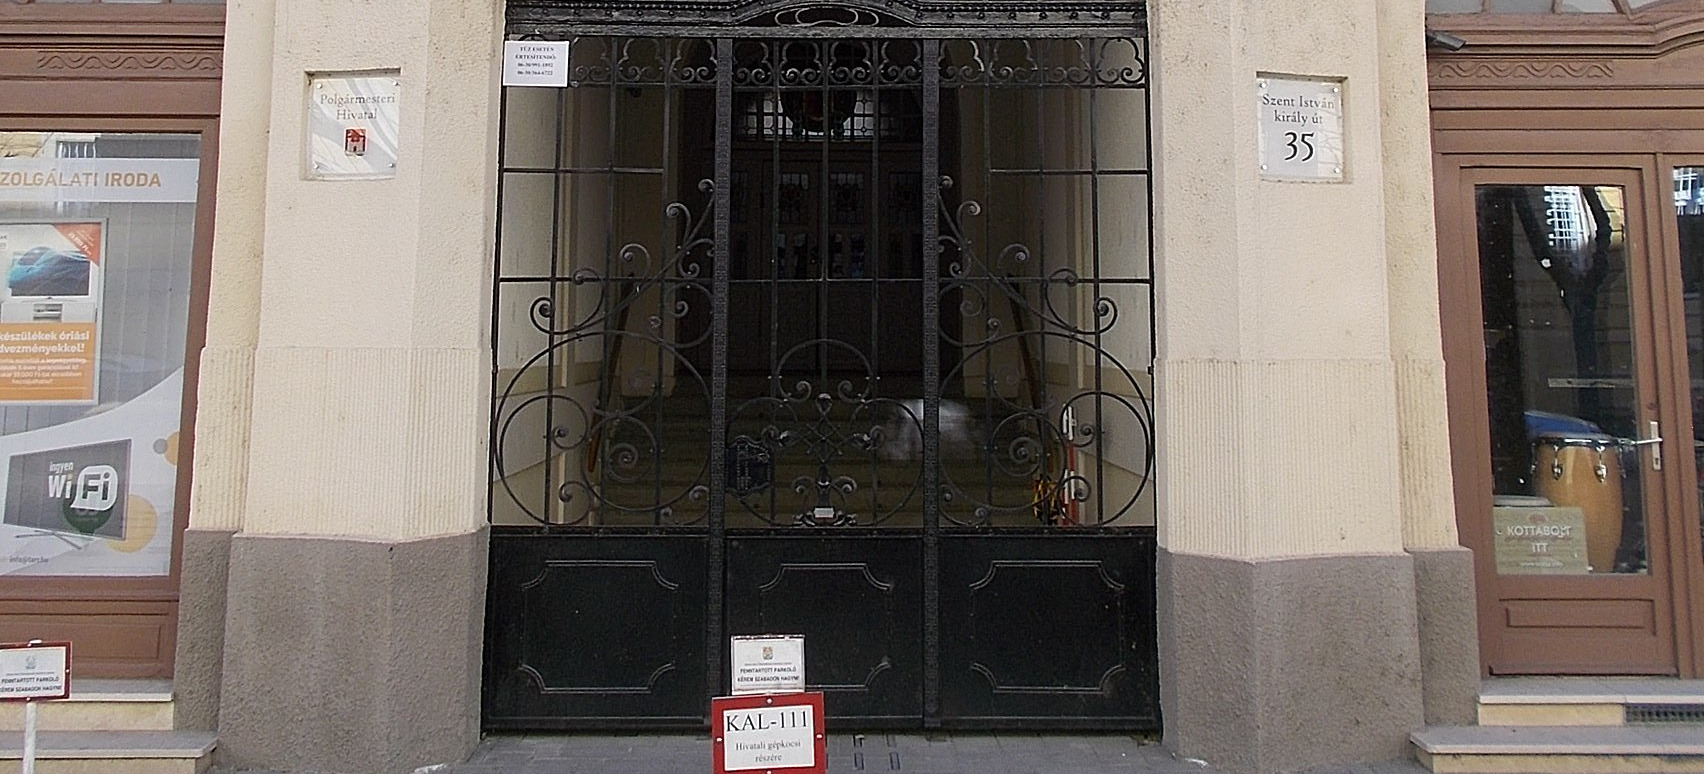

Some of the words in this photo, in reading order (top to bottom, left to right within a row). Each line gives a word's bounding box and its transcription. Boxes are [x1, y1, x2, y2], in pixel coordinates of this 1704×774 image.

[320, 92, 396, 107] Polgármesteri
[1262, 94, 1295, 106] Szent
[1299, 95, 1335, 109] István
[336, 108, 377, 120] Hivatal
[1274, 109, 1308, 127] király
[1311, 112, 1323, 124] út
[1284, 131, 1315, 162] 35
[104, 172, 161, 187] IRODA
[49, 461, 73, 474] ingyen
[1532, 542, 1548, 553] ITT
[726, 711, 807, 732] KAL-111
[736, 742, 766, 751] Hivatali
[767, 740, 801, 751] gépkocsi
[755, 753, 782, 762] részére
